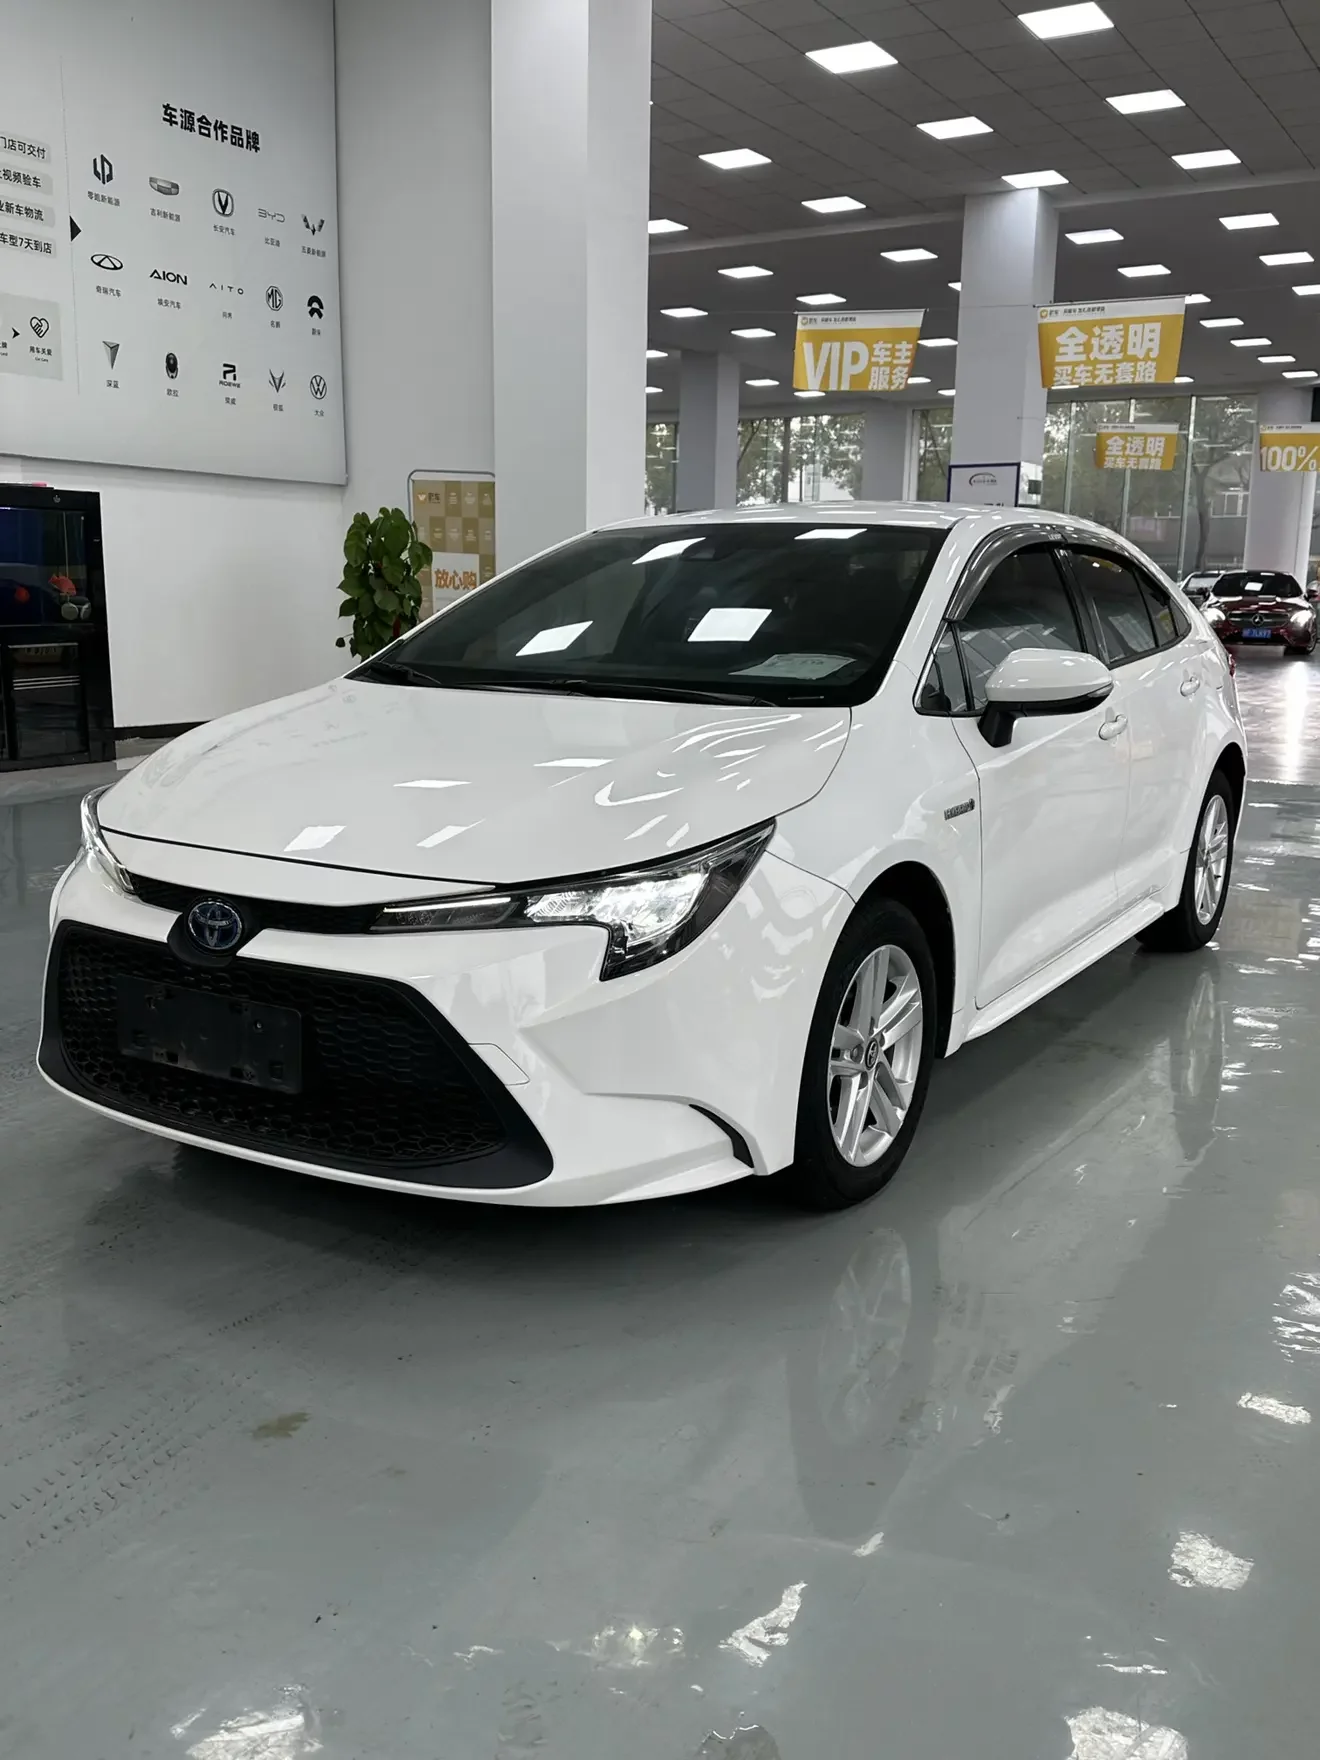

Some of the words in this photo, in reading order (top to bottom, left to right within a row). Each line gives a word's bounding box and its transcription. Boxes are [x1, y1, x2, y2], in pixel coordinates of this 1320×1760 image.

[162, 103, 261, 153] 车源合作品牌
[0, 168, 42, 188] 视频验车
[149, 268, 188, 285] AION
[209, 282, 244, 295] AITO
[871, 341, 913, 365] 车主
[1055, 322, 1161, 362] 全透明
[803, 341, 869, 391] VIP
[1053, 361, 1157, 386] 买车无套路
[868, 366, 909, 391] 服务
[1104, 436, 1166, 457] 全透明
[1260, 445, 1319, 472] 100%
[434, 568, 477, 590] 放心购
